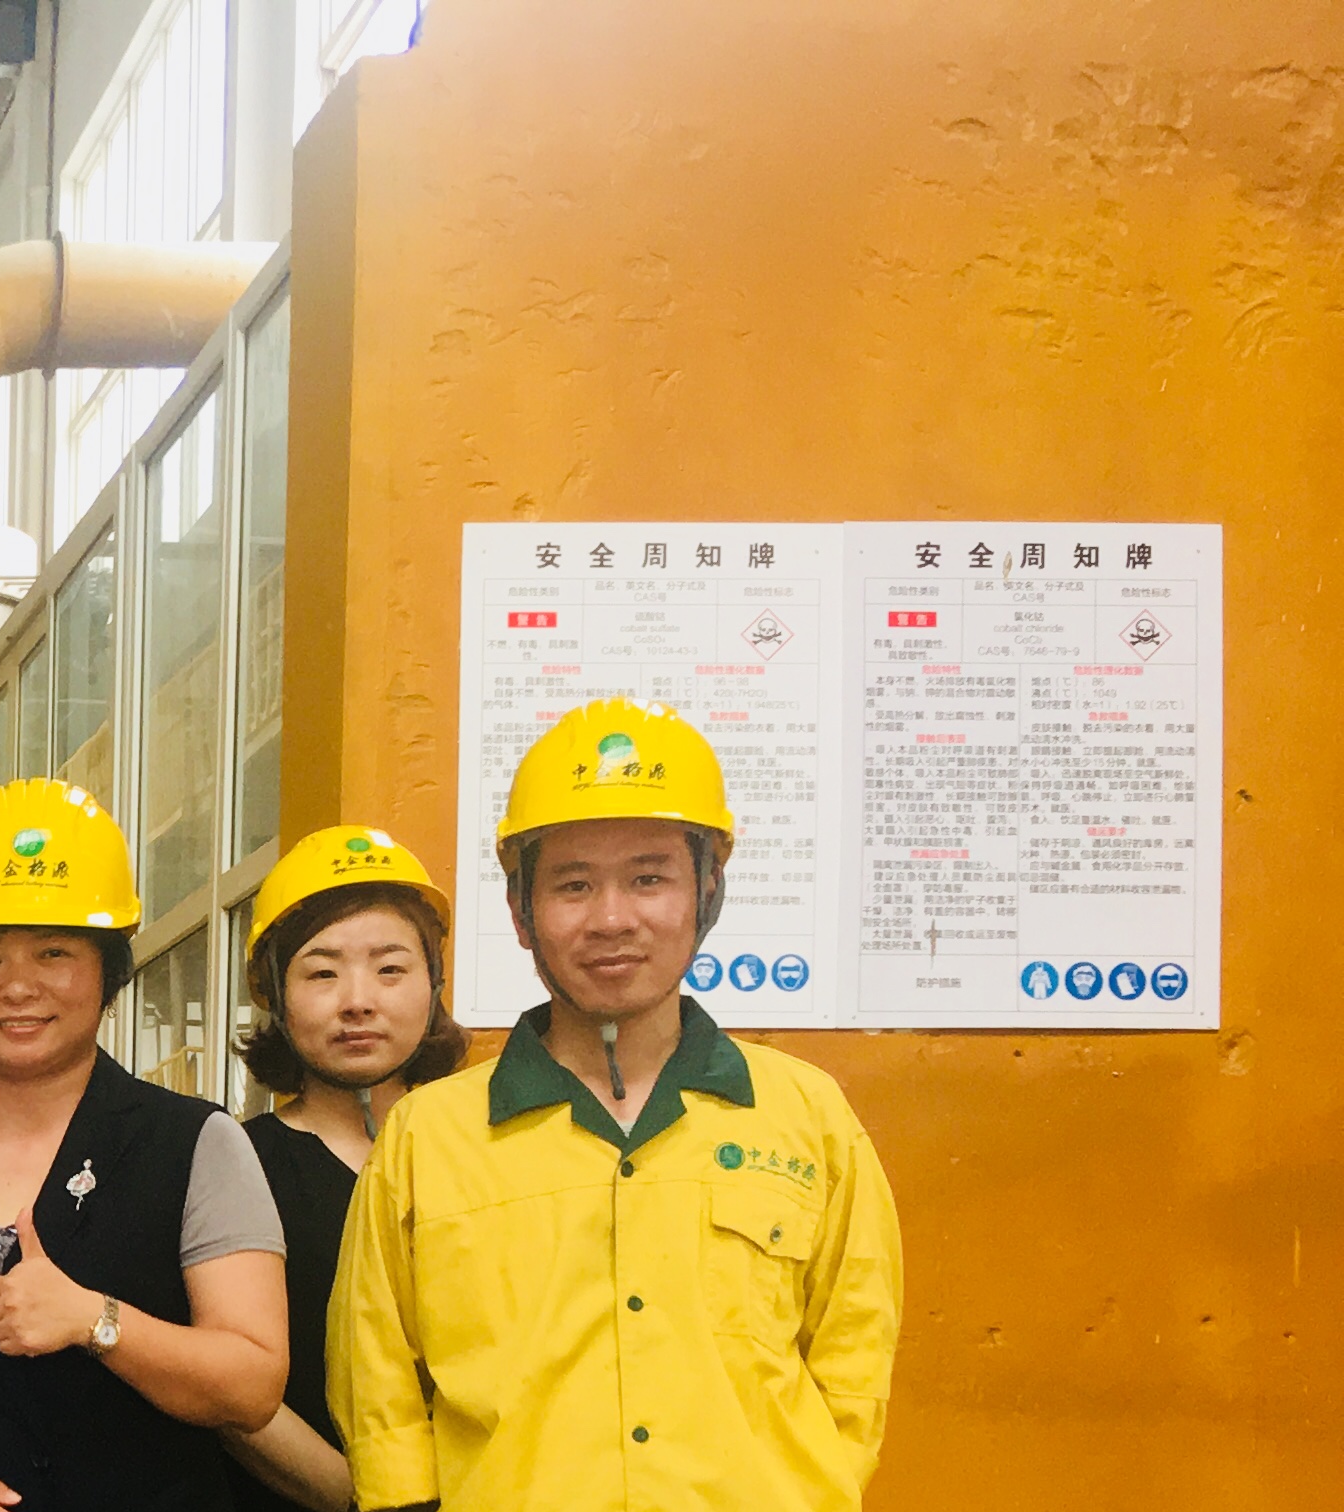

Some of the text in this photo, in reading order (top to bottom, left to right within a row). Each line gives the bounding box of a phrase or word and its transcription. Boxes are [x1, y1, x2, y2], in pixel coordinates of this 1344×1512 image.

[534, 541, 776, 569] 安全周知牌
[914, 541, 1153, 569] 安全周知牌
